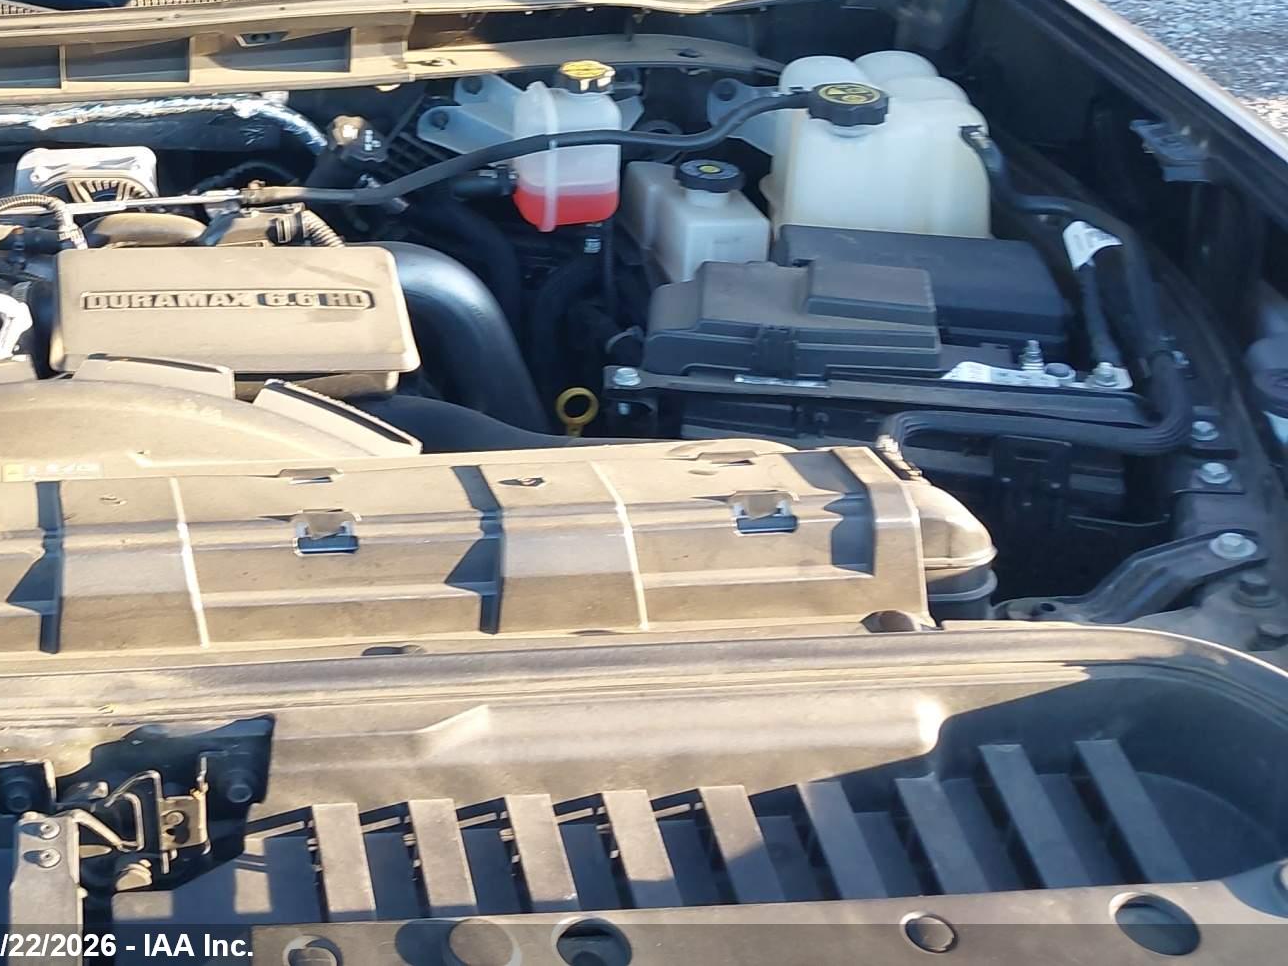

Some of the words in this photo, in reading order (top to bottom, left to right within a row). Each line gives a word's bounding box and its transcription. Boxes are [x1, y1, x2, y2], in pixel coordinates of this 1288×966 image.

[85, 291, 254, 309] DURAMAX
[264, 291, 316, 307] 6.6
[325, 291, 371, 307] HD
